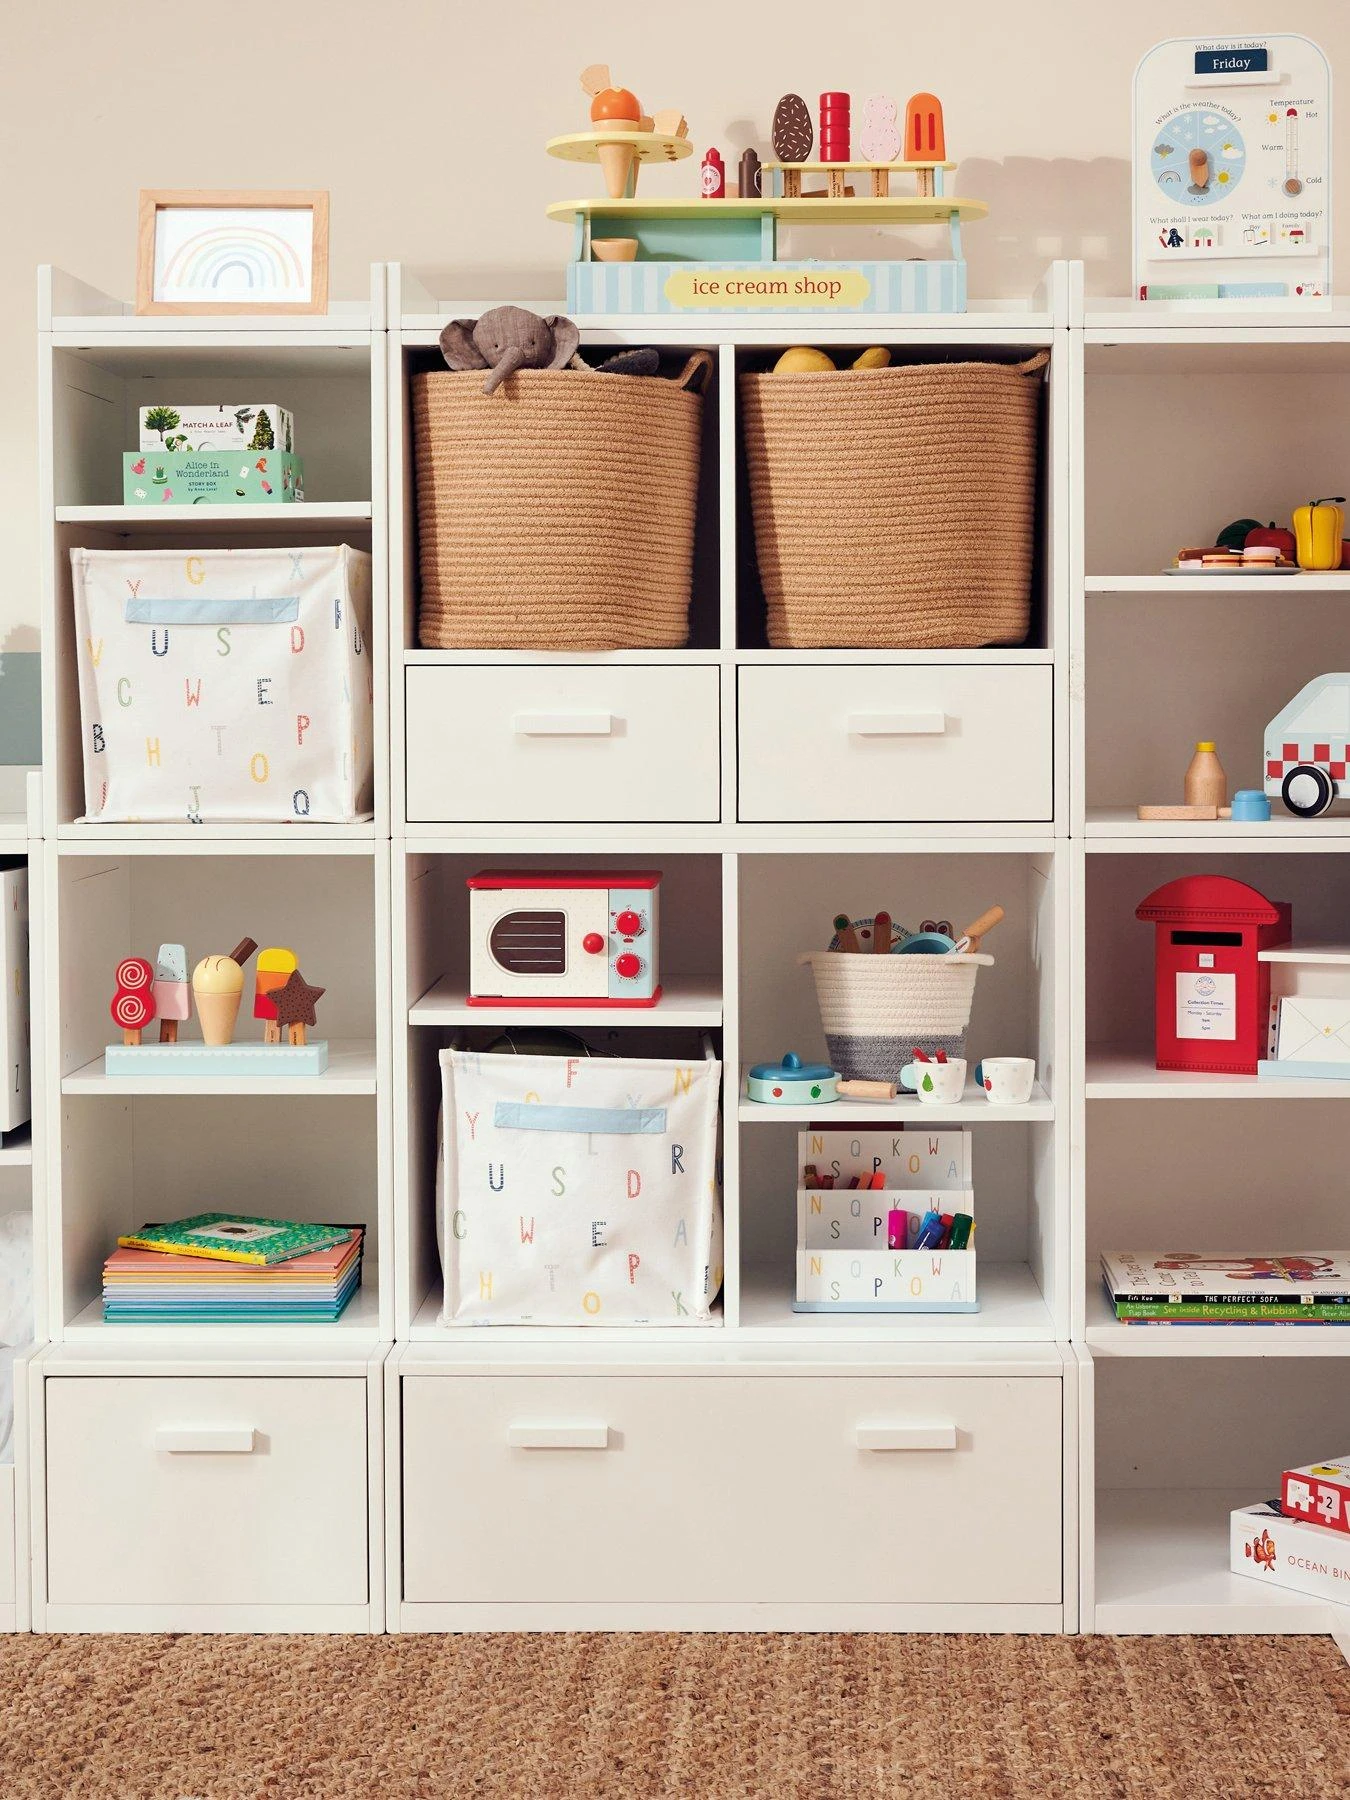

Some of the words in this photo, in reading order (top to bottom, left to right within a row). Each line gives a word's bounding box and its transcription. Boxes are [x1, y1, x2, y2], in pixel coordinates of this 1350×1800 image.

[1213, 58, 1251, 70] Friday
[1156, 110, 1173, 125] What
[1192, 101, 1220, 110] weather
[1221, 106, 1242, 122] today?
[1270, 99, 1314, 108] Temperature
[1210, 214, 1234, 222] today?
[1279, 212, 1299, 220] doing
[1300, 210, 1323, 218] today?
[692, 278, 720, 295] ice
[726, 281, 788, 294] cream
[794, 276, 842, 299] shop
[176, 470, 230, 478] Wonderland
[186, 462, 208, 470] Alice
[288, 552, 304, 580] X
[126, 579, 141, 598] Y
[152, 630, 168, 657] U
[216, 628, 231, 656] S
[290, 626, 305, 654] D
[117, 678, 132, 706] C
[184, 678, 202, 706] W
[257, 678, 274, 706] E
[92, 724, 106, 754] B
[210, 725, 227, 756] T
[296, 714, 310, 746] P
[146, 736, 160, 767] H
[250, 752, 270, 784] O
[293, 789, 310, 816] Q
[567, 1059, 580, 1088] F
[673, 1068, 693, 1096] N
[464, 1111, 480, 1140] Y
[672, 1144, 684, 1174] R
[812, 1136, 823, 1154] N
[850, 1140, 861, 1158] Q
[892, 1138, 900, 1157] K
[928, 1137, 939, 1156] W
[488, 1163, 504, 1192] U
[831, 1160, 840, 1178] S
[873, 1157, 882, 1174] P
[908, 1154, 920, 1174] O
[947, 1160, 958, 1178] A
[551, 1166, 567, 1197] S
[627, 1169, 642, 1198] D
[810, 1196, 822, 1215] N
[850, 1200, 861, 1218] Q
[930, 1197, 940, 1214] W
[452, 1210, 468, 1240] C
[520, 1216, 536, 1244] W
[592, 1220, 608, 1248] E
[674, 1218, 688, 1248] A
[830, 1220, 840, 1239] S
[874, 1217, 882, 1236] P
[910, 1216, 920, 1234] O
[544, 1264, 560, 1293] T
[628, 1254, 640, 1284] P
[810, 1257, 822, 1276] N
[850, 1260, 862, 1278] Q
[894, 1258, 903, 1278] K
[932, 1258, 942, 1276] W
[480, 1272, 492, 1300] H
[830, 1281, 840, 1300] S
[874, 1278, 883, 1297] P
[910, 1276, 922, 1296] O
[951, 1282, 962, 1300] A
[582, 1292, 601, 1315] O
[671, 1290, 689, 1316] K
[1164, 1306, 1177, 1314] See
[1202, 1304, 1248, 1316] Recycling
[1250, 1306, 1258, 1315] &
[1260, 1306, 1298, 1315] Rubbish
[1326, 1496, 1332, 1510] 2
[1288, 1555, 1328, 1574] OCEAN
[1333, 1568, 1350, 1581] BIN
